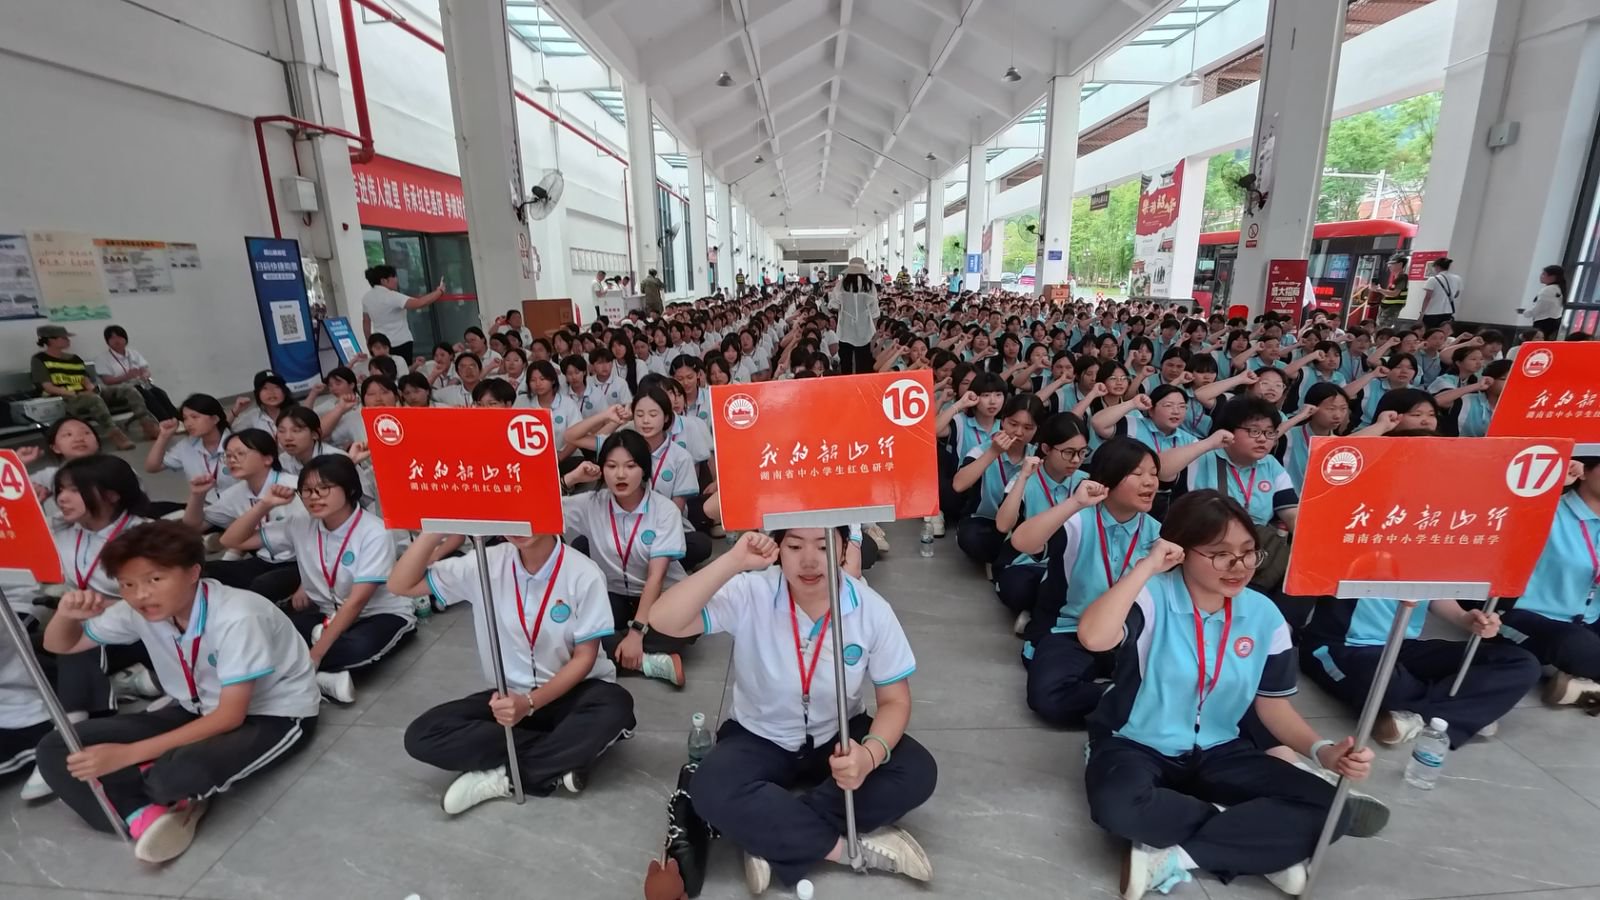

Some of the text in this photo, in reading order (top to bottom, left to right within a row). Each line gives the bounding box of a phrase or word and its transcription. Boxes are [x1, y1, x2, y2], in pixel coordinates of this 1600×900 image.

[885, 385, 926, 420] 16
[510, 421, 547, 450] 15
[0, 463, 22, 493] 4
[760, 462, 895, 481] 湖南省中小学生红色研学
[1513, 453, 1560, 490] 17
[410, 482, 523, 494] 湖南省中小学生红色研学
[1342, 533, 1501, 545] 湖南省中小学生红色研学
